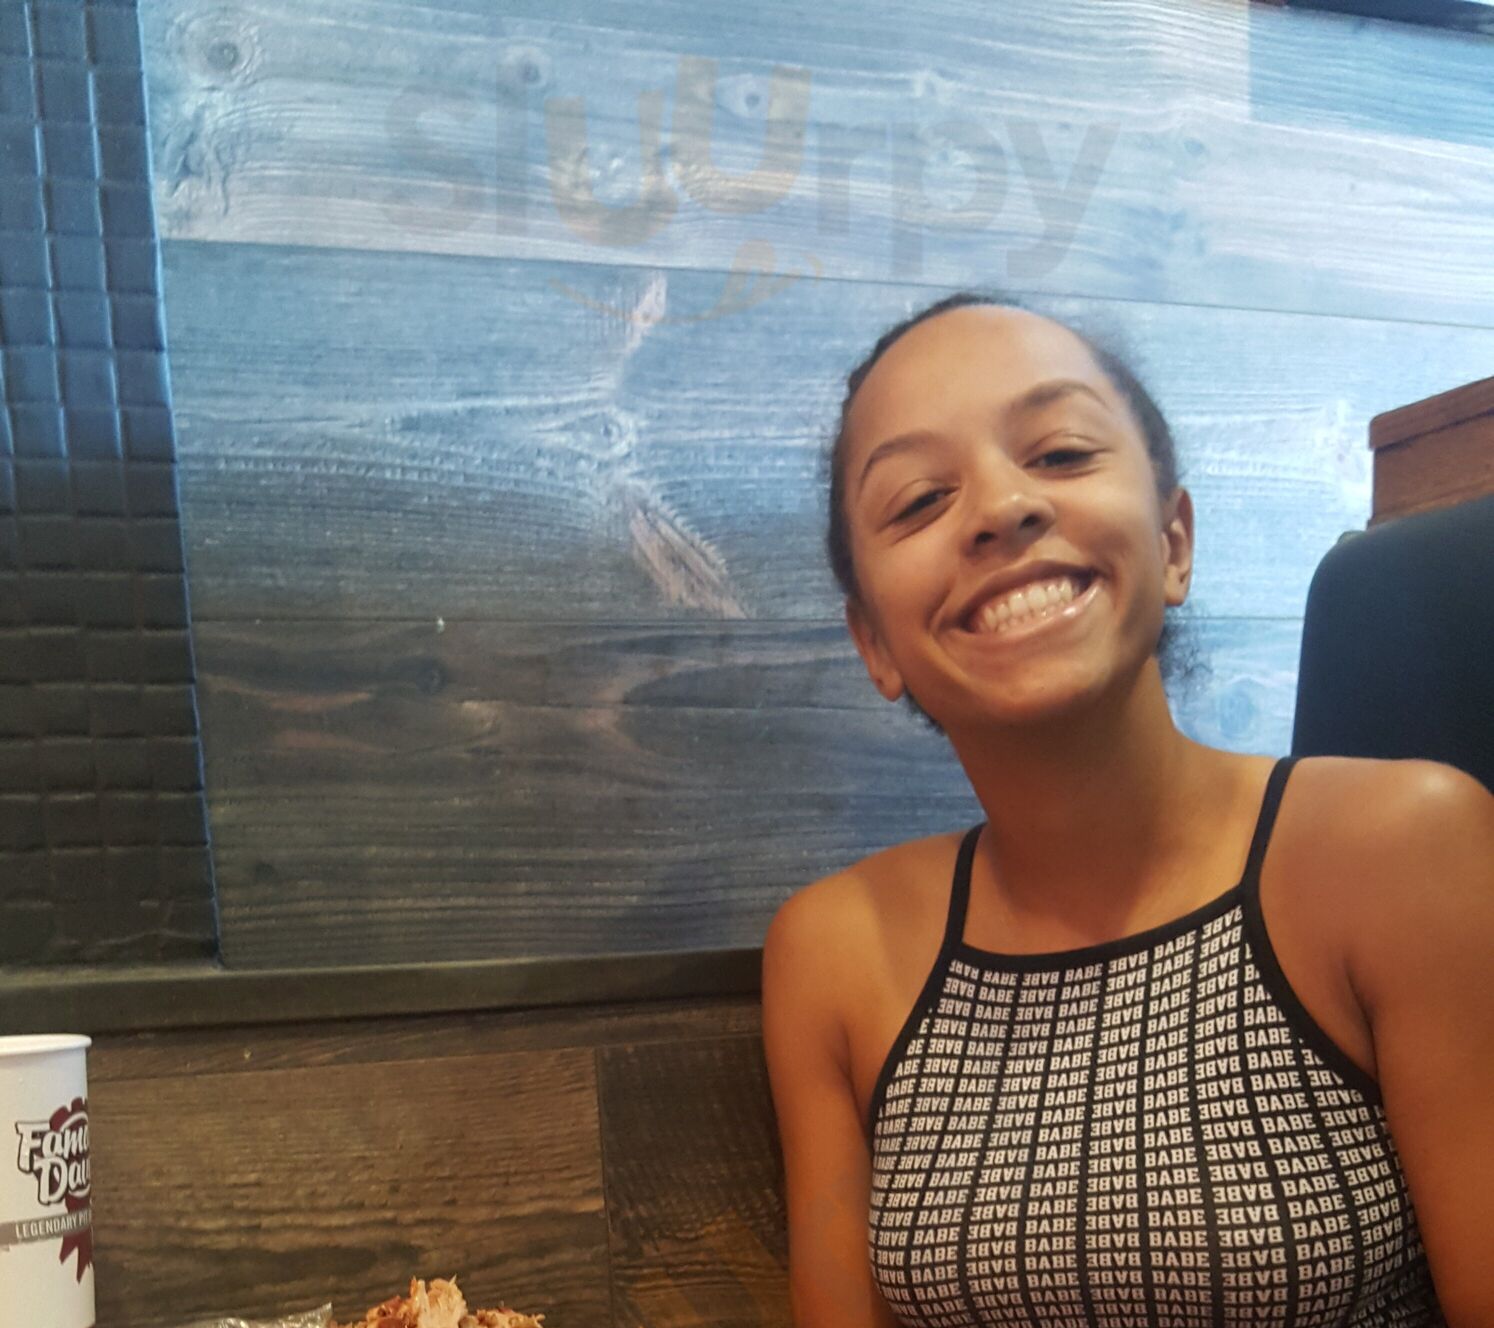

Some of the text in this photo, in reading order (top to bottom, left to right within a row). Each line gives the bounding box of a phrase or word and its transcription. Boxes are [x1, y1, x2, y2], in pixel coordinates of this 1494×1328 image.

[938, 998, 971, 1016] BABE
[975, 1004, 1010, 1020] BABE
[1016, 1006, 1053, 1020] BABE
[1058, 998, 1098, 1017] BABE
[1104, 986, 1145, 1009] BABE
[1150, 969, 1192, 996] BABE
[1198, 947, 1240, 978] BABE
[944, 926, 1242, 1003] BABE BABE BABE BABE BABE BABE BABE
[983, 971, 1018, 986] BABE
[1022, 972, 1059, 986] BABE
[1064, 964, 1102, 982] BABE
[1108, 950, 1148, 974] BABE
[1154, 930, 1196, 960] BABE
[928, 1038, 963, 1054] BABE
[967, 1041, 1004, 1056] BABE
[1008, 1040, 1048, 1056] BABE
[1053, 1034, 1094, 1052] BABE
[1100, 1024, 1141, 1045] BABE
[1147, 1008, 1189, 1034] BABE
[1196, 990, 1237, 1018] BABE
[932, 1018, 967, 1036] BABE
[971, 1023, 1008, 1038] BABE
[1012, 1023, 1050, 1038] BABE
[1056, 1016, 1096, 1034] BABE
[1102, 1005, 1143, 1027] BABE
[1149, 988, 1190, 1015] BABE
[1197, 969, 1238, 998] BABE
[919, 1028, 1291, 1092] BABE BABE BABE BABE BABE BABE BABE BABE
[923, 1013, 1237, 1074] BABE BABE BABE BABE BABE BABE BABE
[909, 1072, 1301, 1131] BABE BABE BABE BABE BABE BABE BABE BABE
[914, 1097, 950, 1112] BABE
[953, 1097, 992, 1111] BABE
[997, 1094, 1039, 1110] BABE
[1044, 1088, 1087, 1106] BABE
[1094, 1079, 1137, 1100] BABE
[1144, 1068, 1188, 1091] BABE
[1195, 1056, 1241, 1080] BABE
[1247, 1050, 1296, 1069] BABE
[898, 1107, 1370, 1170] BABE BABE BABE BABE BABE BABE BABE BABE BABE
[904, 1135, 938, 1150] BABE
[942, 1134, 983, 1149] BABE
[988, 1130, 1032, 1146] BABE
[1038, 1124, 1083, 1142] BABE
[1091, 1117, 1136, 1136] BABE
[1144, 1108, 1191, 1129] BABE
[1198, 1098, 1249, 1120] BABE
[1255, 1093, 1308, 1112] BABE
[886, 1143, 1384, 1207] BABE BABE BABE BABE BABE BABE BABE BABE BABE
[892, 1125, 1377, 1188] BABE BABE BABE BABE BABE BABE BABE BABE BABE
[913, 1179, 1396, 1245] BABE BABE BABE BABE BABE BABE BABE BABE
[917, 1161, 1390, 1225] BABE BABE BABE BABE BABE BABE BABE BABE
[15, 1213, 78, 1240] LEGENDARY
[910, 1214, 1351, 1265] BABE BABE BABE BABE BABE BABE BABE
